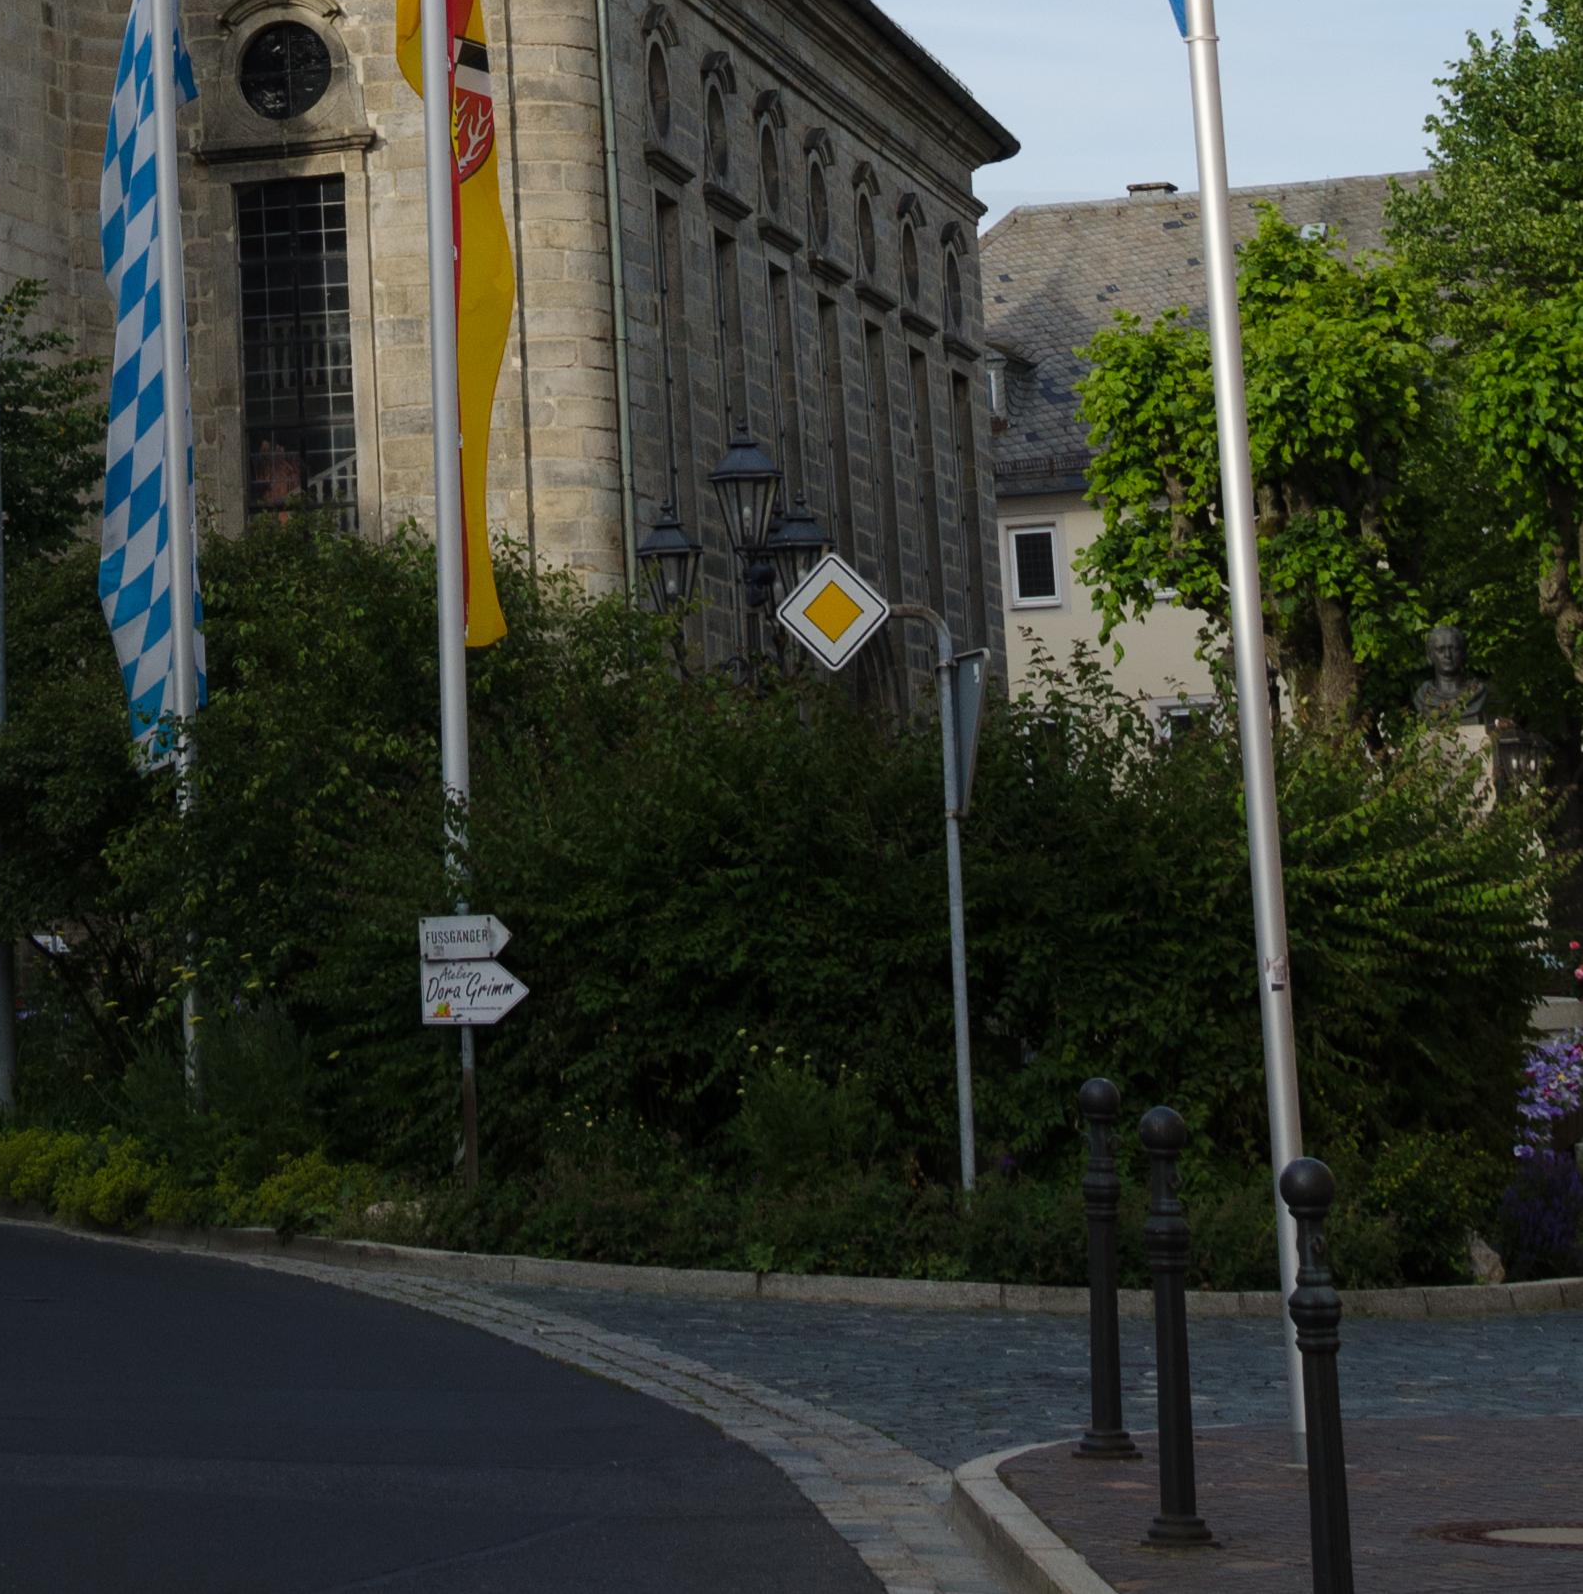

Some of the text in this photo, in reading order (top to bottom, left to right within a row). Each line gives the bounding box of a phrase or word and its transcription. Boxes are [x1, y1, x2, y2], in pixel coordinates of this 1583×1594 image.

[425, 928, 489, 944] FUSSGÄNGER
[439, 966, 474, 982] Atelier
[426, 972, 515, 1006] Dora Grimm
